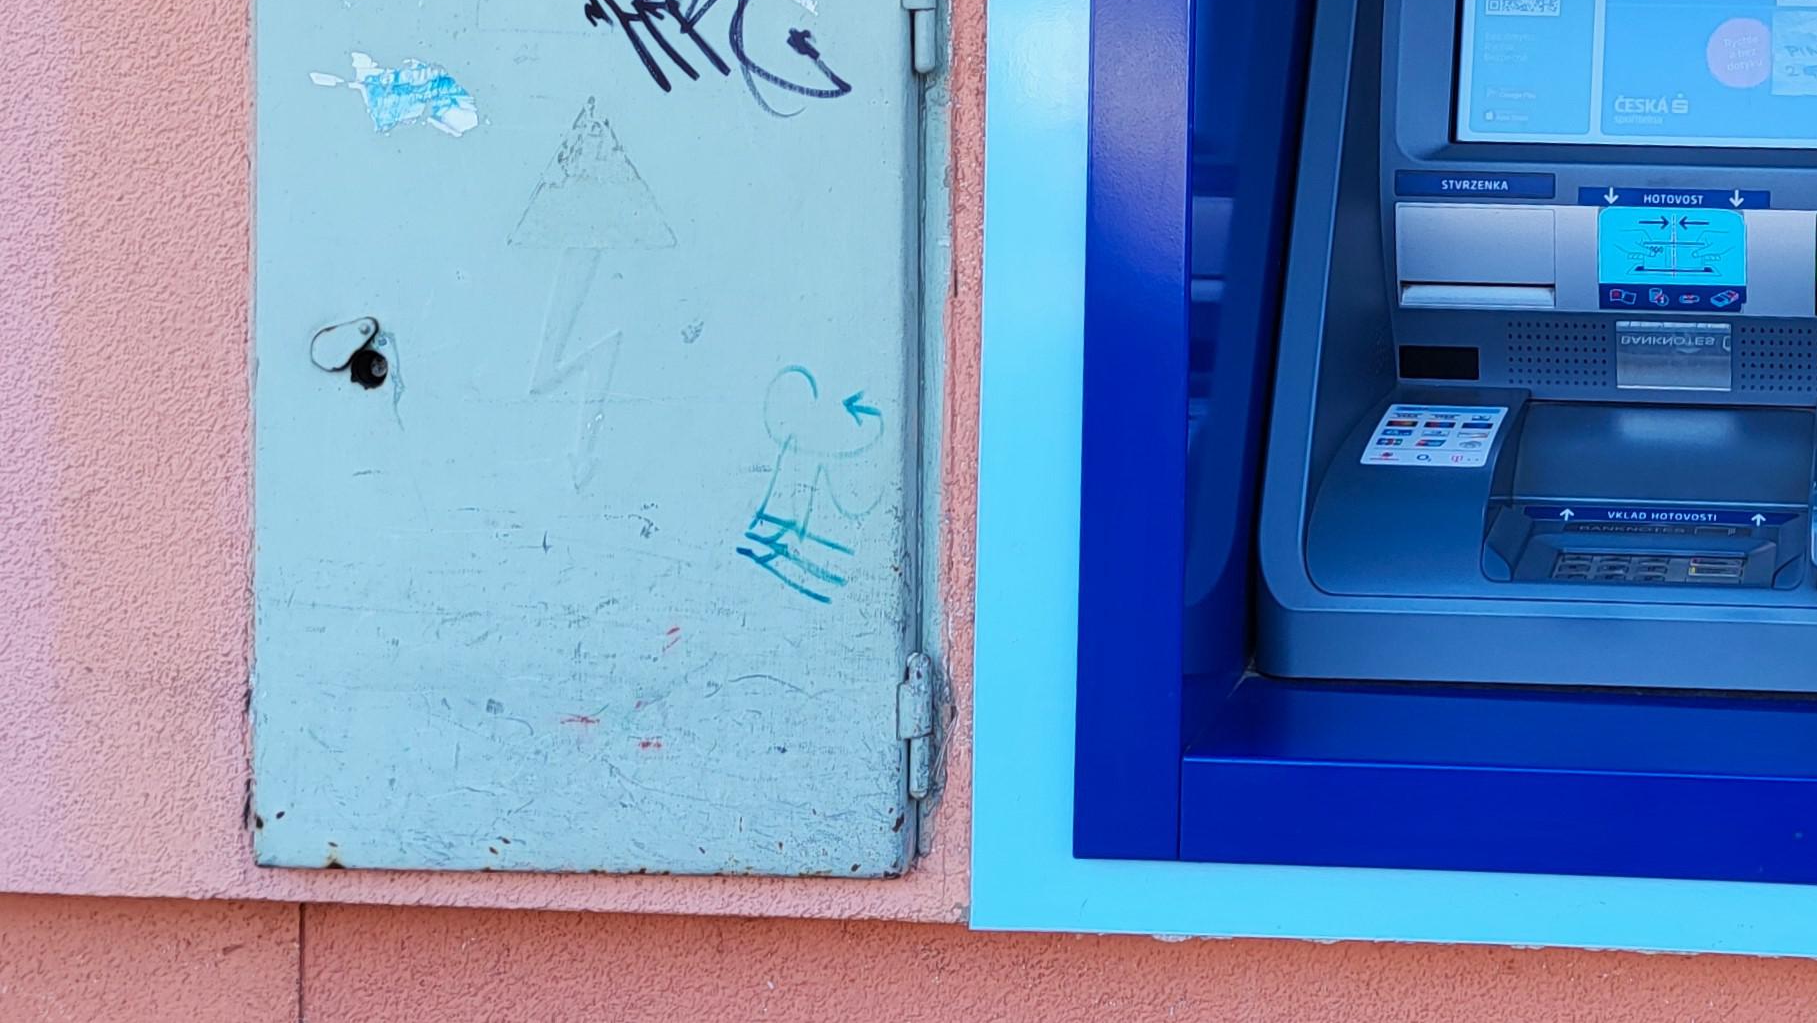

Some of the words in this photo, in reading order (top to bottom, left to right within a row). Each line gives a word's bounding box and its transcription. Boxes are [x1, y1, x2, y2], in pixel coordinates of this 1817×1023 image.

[1614, 94, 1668, 114] ČESKÁ
[1441, 178, 1509, 192] STVRZENKA
[1643, 192, 1704, 206] HOTOVOST
[1607, 510, 1647, 520] VKLAD
[1651, 511, 1717, 522] HOTOVOSTI
